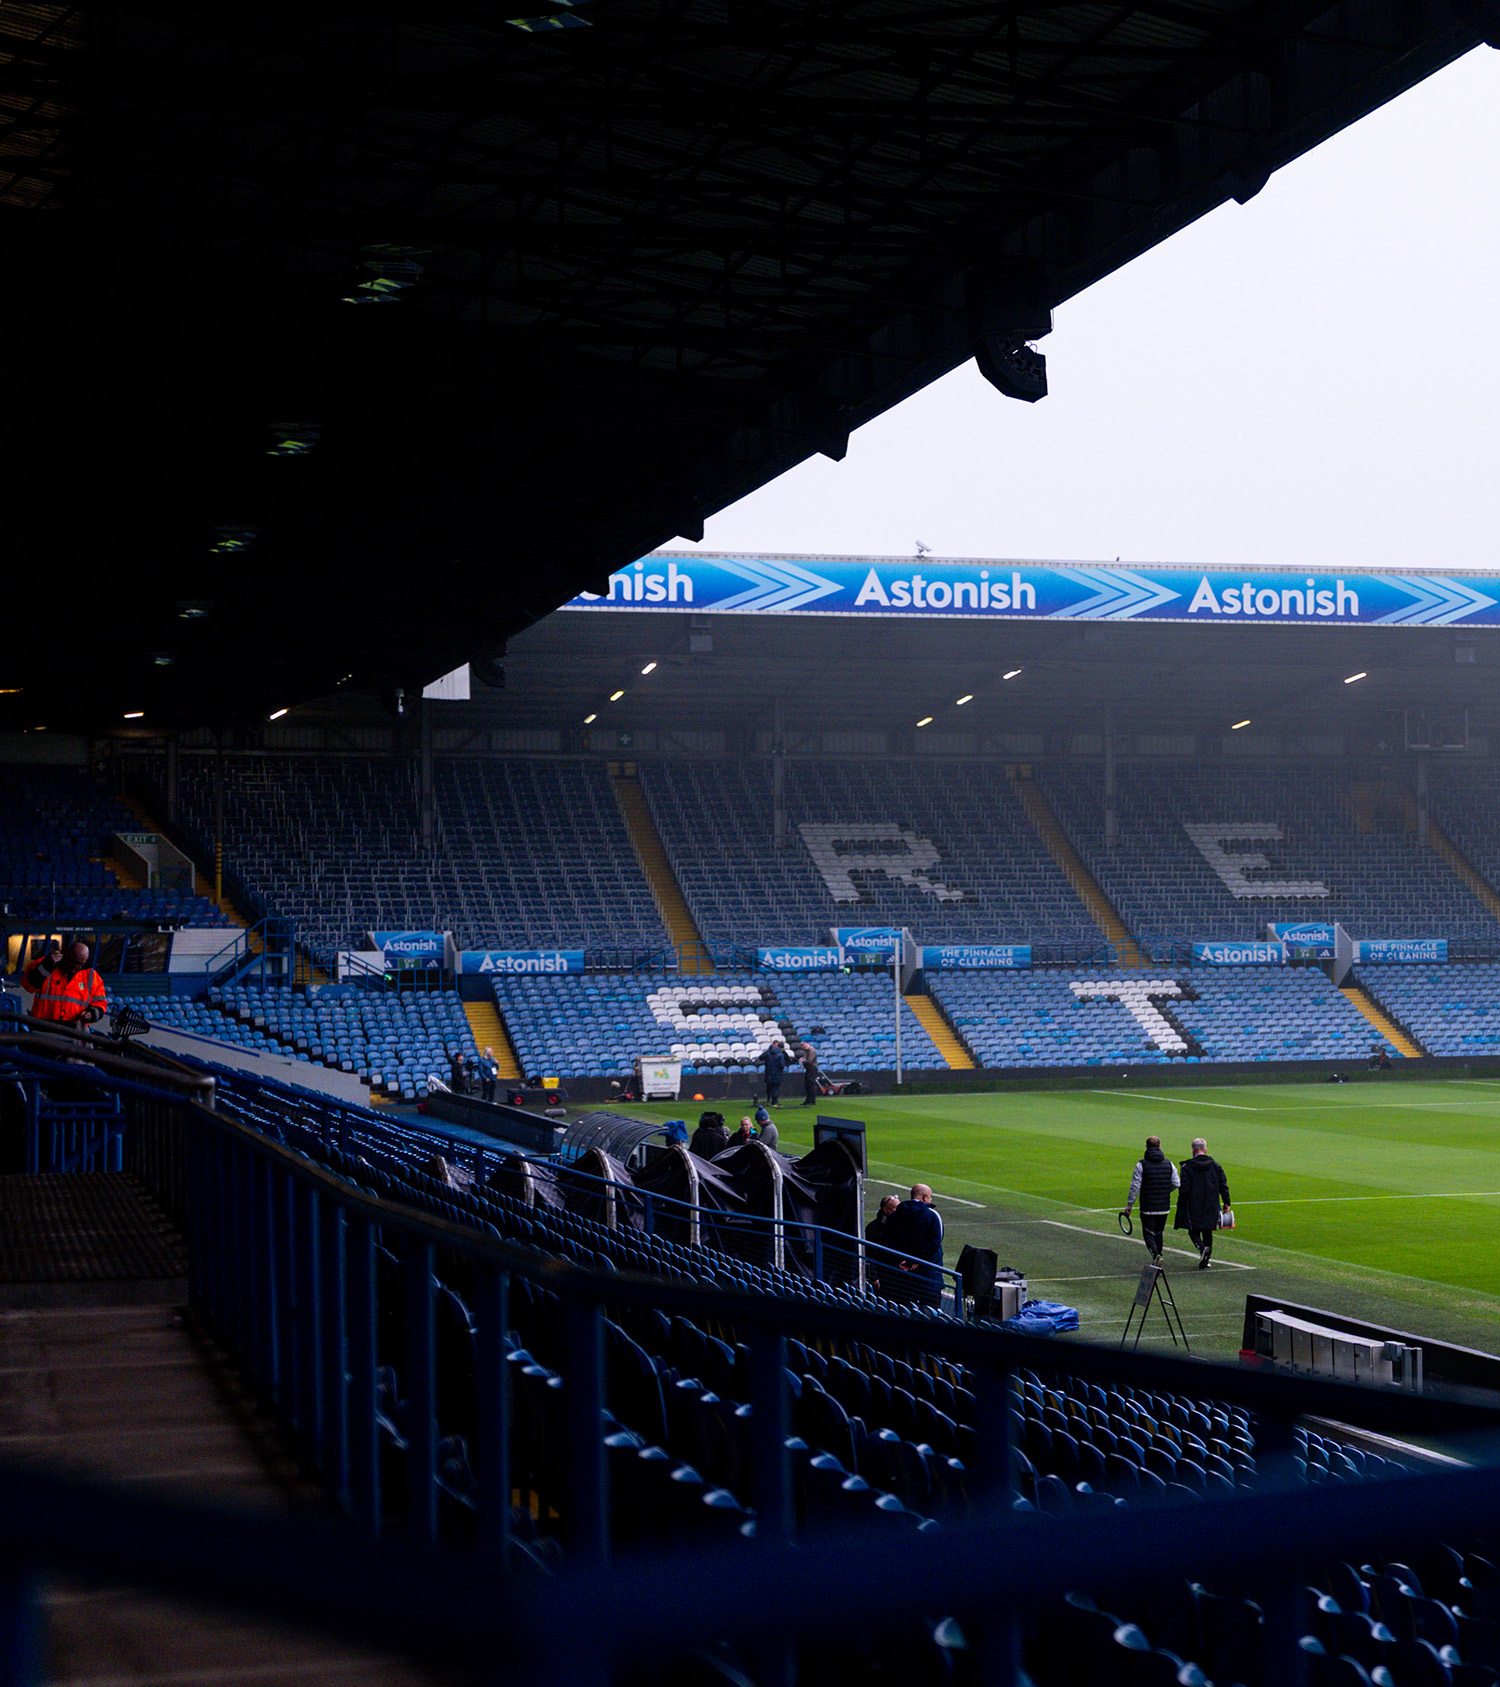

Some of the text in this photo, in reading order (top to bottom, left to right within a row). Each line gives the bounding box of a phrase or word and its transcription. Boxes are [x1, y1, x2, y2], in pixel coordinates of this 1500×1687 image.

[580, 561, 692, 602] nish
[854, 568, 1036, 609] Astonish
[1188, 576, 1359, 616] Astonish
[127, 835, 148, 843] EXIT
[1282, 930, 1329, 941] Astonish
[383, 940, 437, 951] Astonish
[845, 936, 896, 947] Astonish
[1370, 943, 1437, 951] THE PINNACLE
[941, 949, 1014, 957] THE PINNACLE
[1201, 945, 1278, 962] Astonish
[1370, 951, 1437, 960] OF CLEANING
[479, 953, 568, 973] Astonish
[763, 950, 839, 968] Astonish
[941, 957, 1014, 966] OF CLEANING
